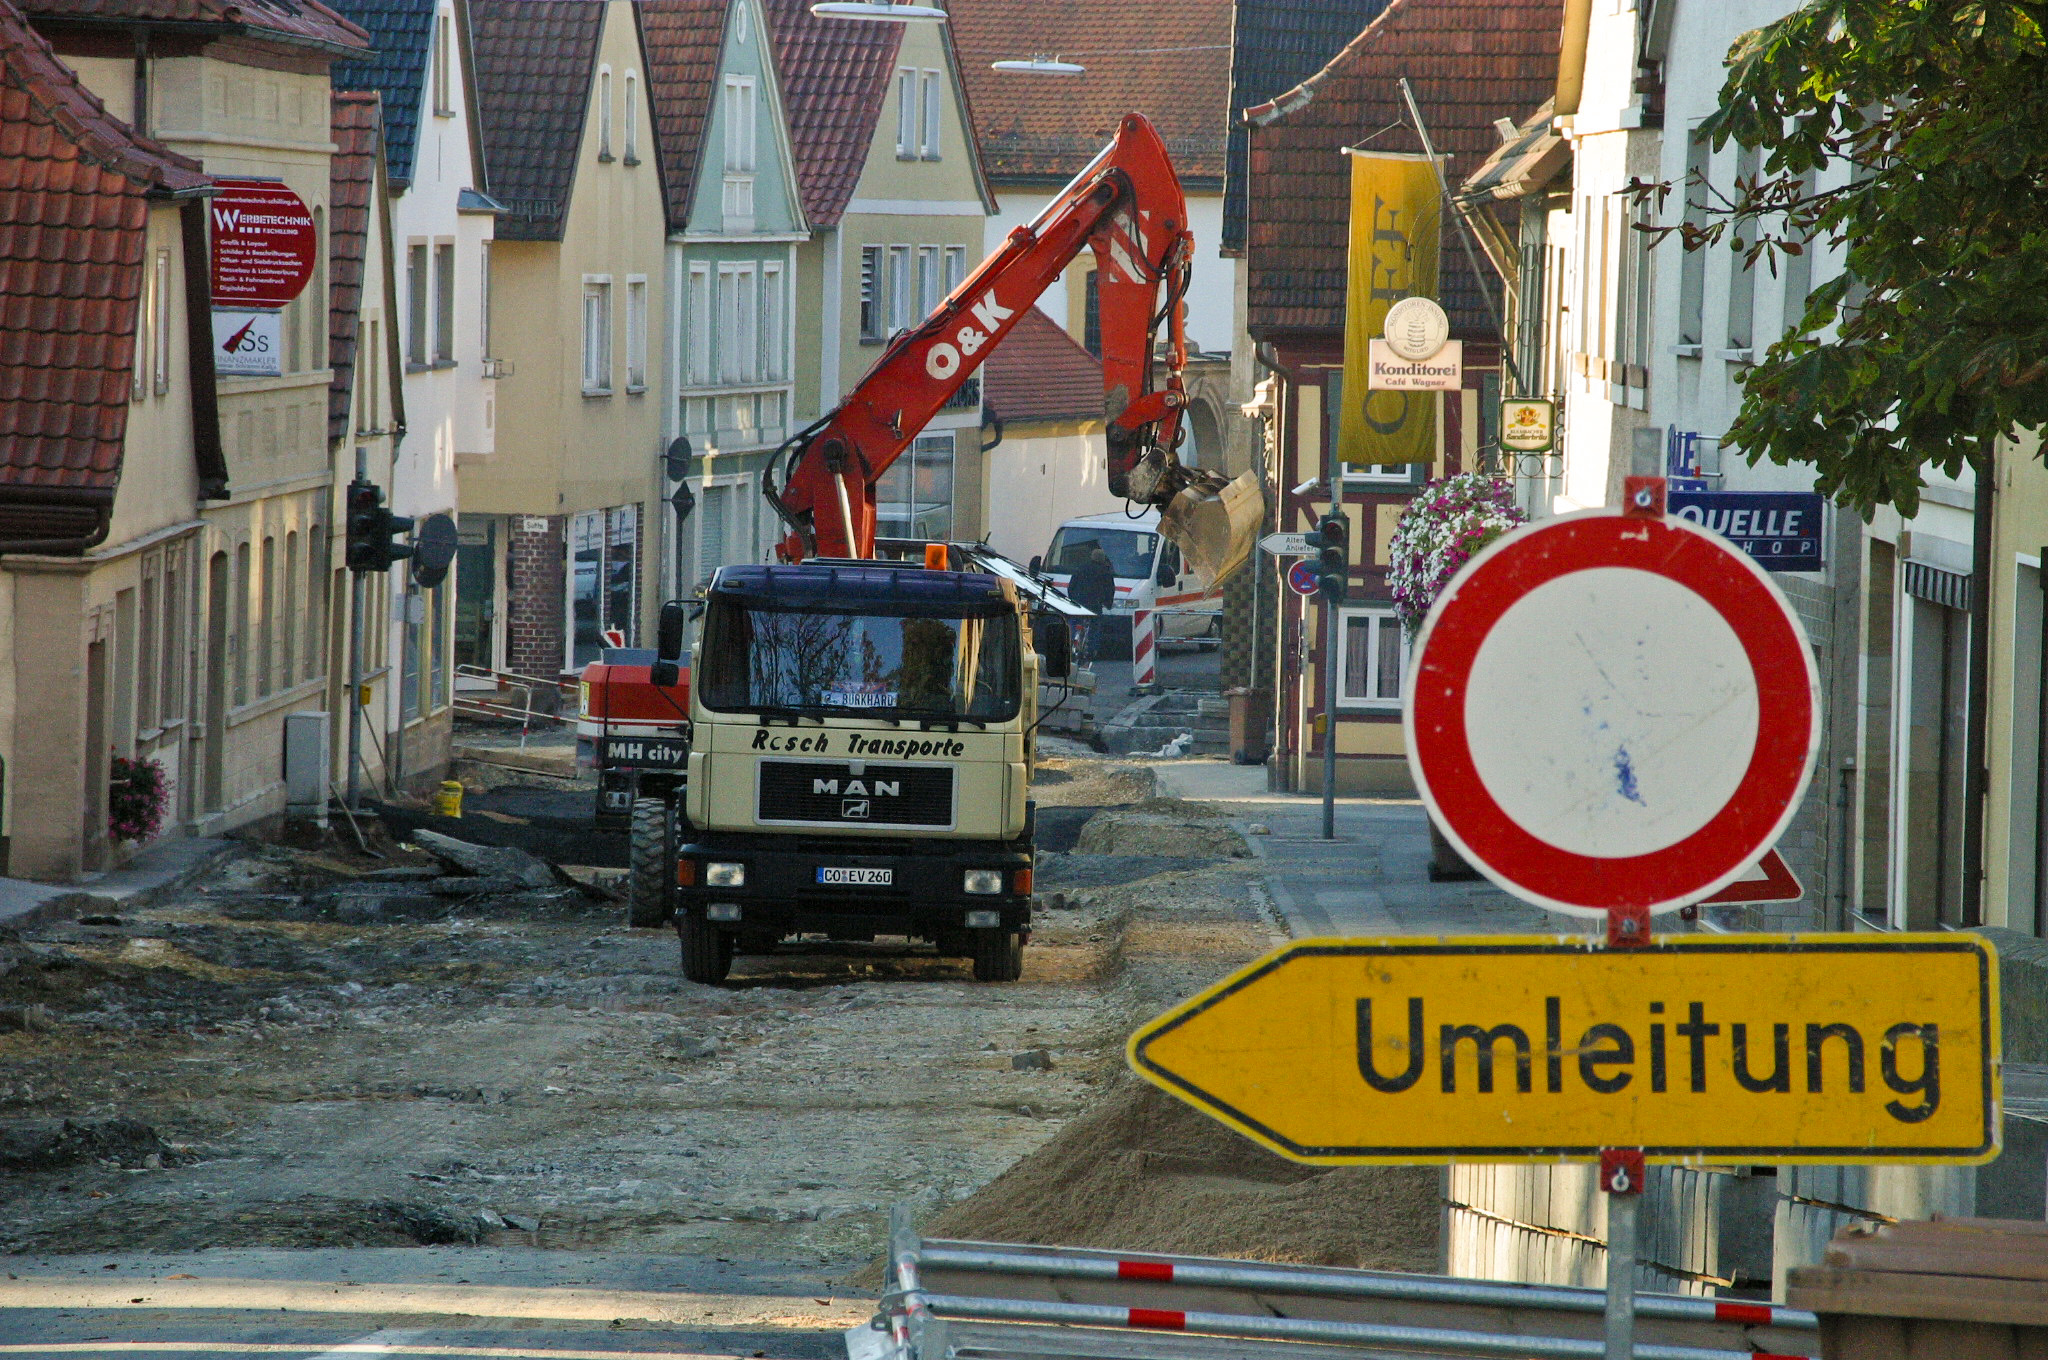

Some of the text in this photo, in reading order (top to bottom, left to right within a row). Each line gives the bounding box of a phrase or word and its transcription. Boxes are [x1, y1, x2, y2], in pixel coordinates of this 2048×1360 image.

[213, 208, 312, 232] WERBETECHNIK
[220, 239, 239, 247] Grafik
[247, 240, 268, 248] Layout
[1374, 362, 1457, 377] Konditorei
[1385, 377, 1447, 388] Café Wagner
[842, 692, 894, 706] BURKHARD
[608, 742, 683, 763] MH city
[848, 734, 964, 760] Transporte
[813, 778, 900, 797] MAN
[824, 869, 891, 883] CO EV 260
[1355, 997, 1940, 1124] Umleitung
